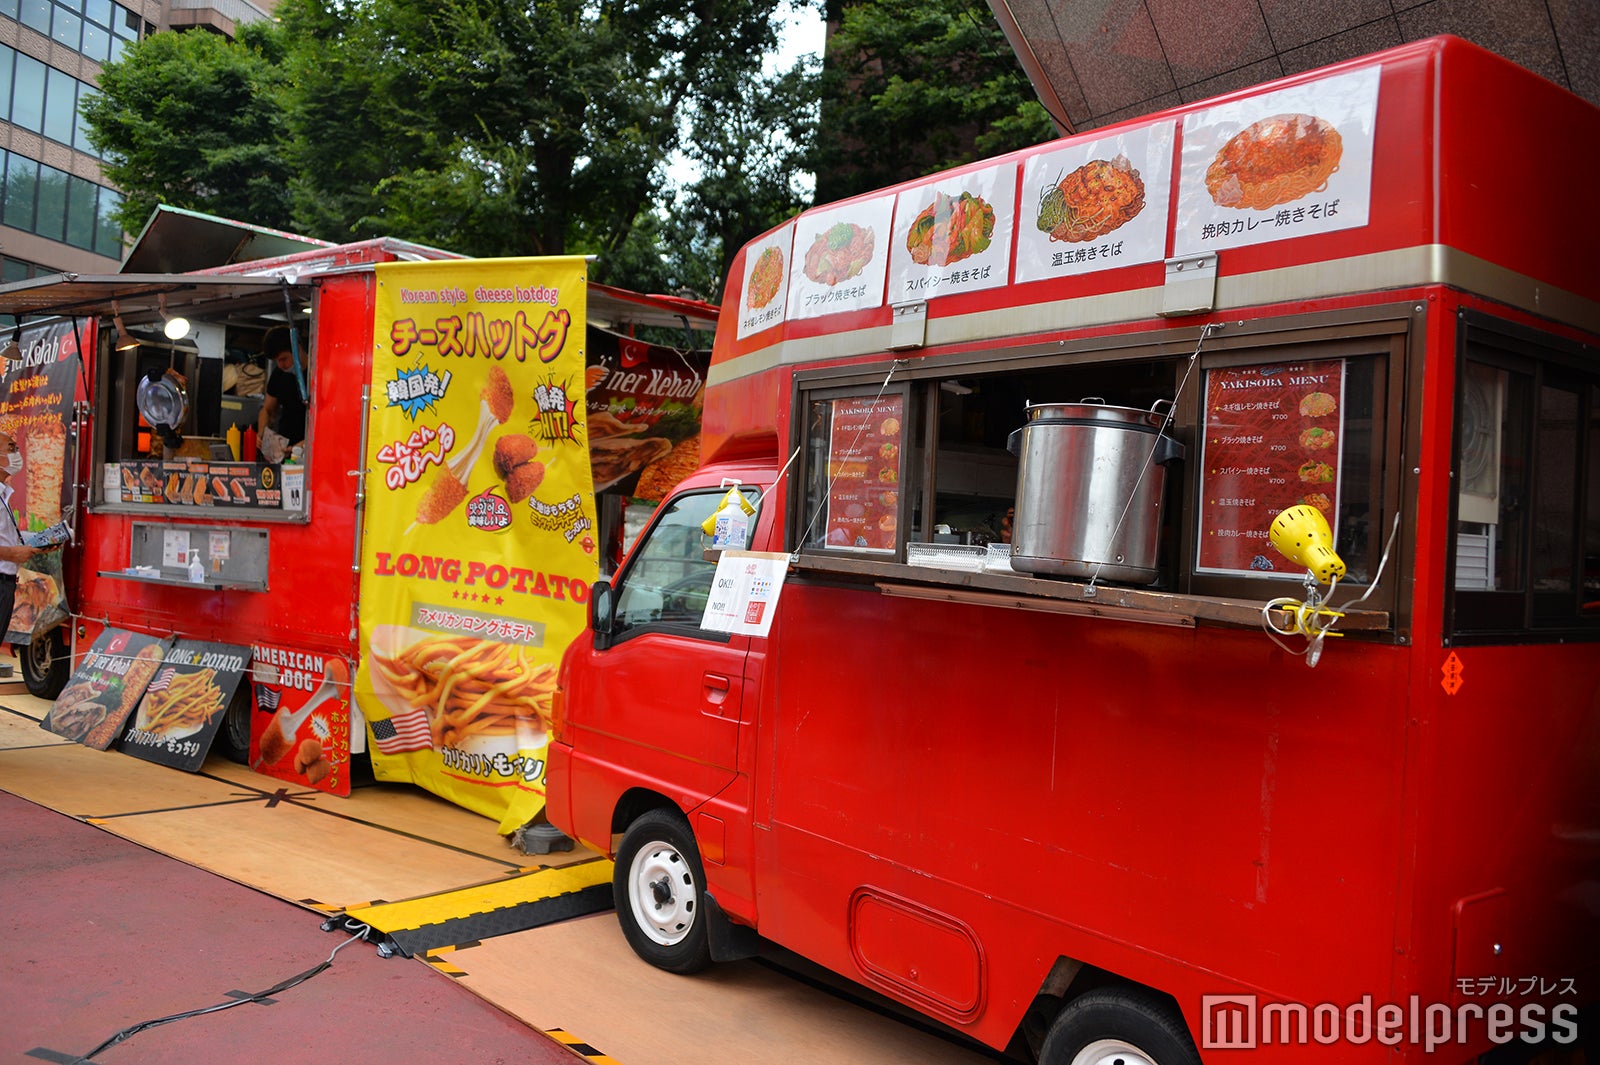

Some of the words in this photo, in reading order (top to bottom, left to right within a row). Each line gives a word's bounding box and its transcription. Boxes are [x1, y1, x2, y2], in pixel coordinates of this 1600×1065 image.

[1201, 199, 1340, 240] 挽肉カレー焼きそば
[1051, 241, 1124, 267] 温玉焼きそば
[905, 265, 991, 292] スパイシー焼きそば
[400, 287, 438, 303] Korean
[440, 287, 467, 306] style
[474, 285, 513, 302] cheese
[515, 285, 558, 306] hotdog
[805, 284, 867, 307] ブラック焼きそば
[390, 310, 570, 363] チーズハットグ
[643, 368, 703, 398] Kebab
[1220, 378, 1283, 390] YAKISOBA
[1289, 374, 1329, 386] MENU
[534, 384, 566, 413] 爆発
[1223, 401, 1280, 411] ネギ塩レモン焼きそば
[540, 411, 569, 439] HIT!
[1221, 436, 1263, 445] ブラック焼きそば
[1219, 467, 1270, 475] スパイシー焼きそば
[374, 552, 462, 583] LONG
[464, 560, 588, 605] POTATO
[718, 578, 735, 589] OK!!
[417, 608, 535, 642] アメリカンロングポテト
[165, 648, 193, 666] LONG
[199, 653, 243, 673] POTATO
[253, 645, 324, 673] AMERICAN
[283, 669, 314, 693] DOG
[339, 699, 349, 763] アメリカン
